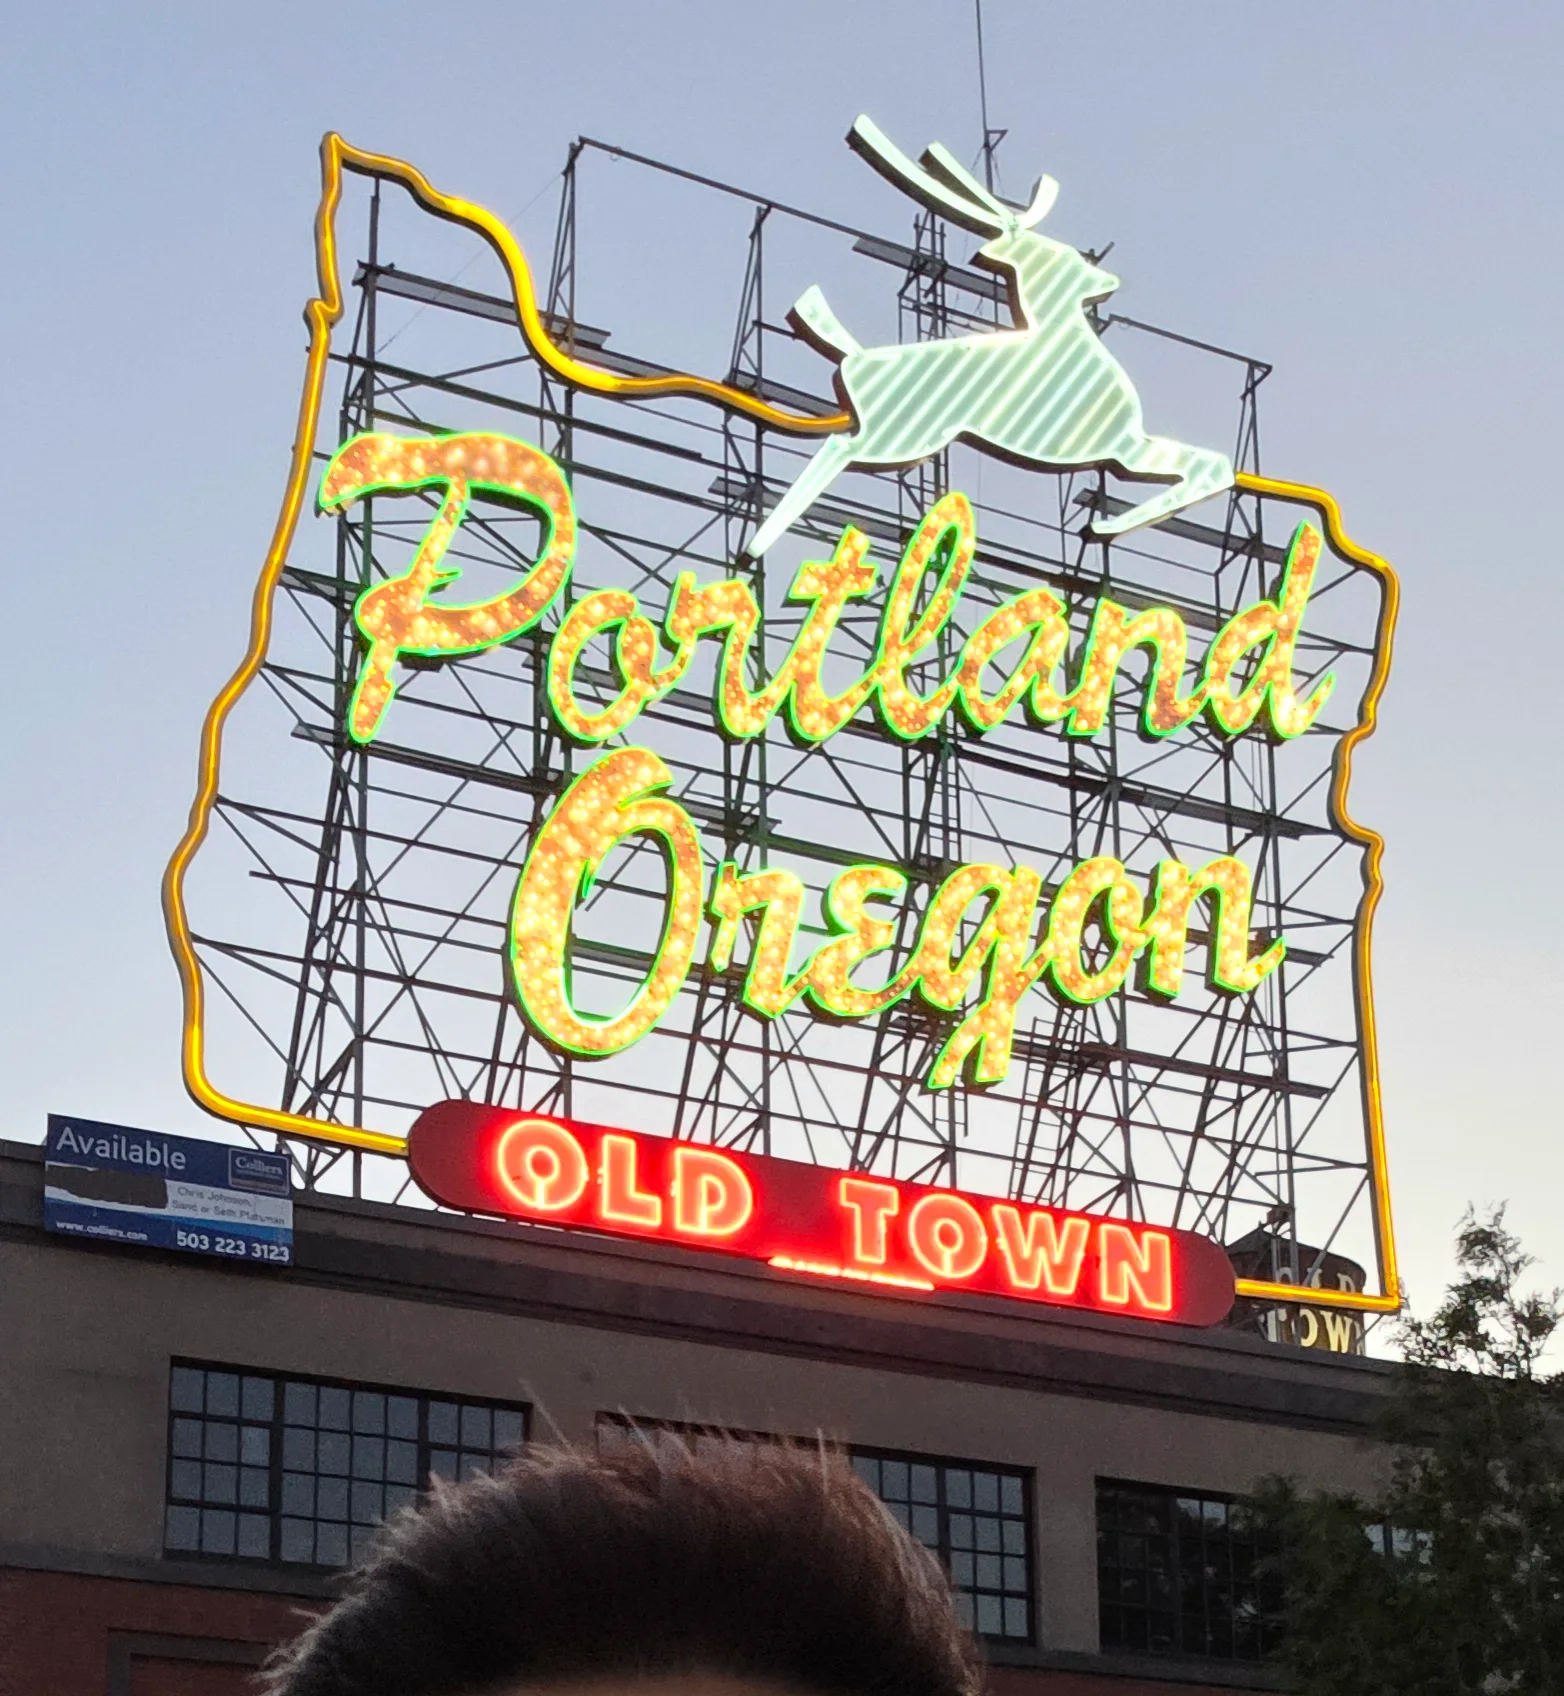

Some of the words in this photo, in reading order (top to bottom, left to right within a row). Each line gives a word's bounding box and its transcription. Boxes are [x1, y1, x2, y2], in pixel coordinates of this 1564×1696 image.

[319, 432, 1334, 744] Portland
[510, 746, 1287, 1088] Oregon
[56, 1126, 186, 1170] Available
[235, 1156, 284, 1176] Colliers
[177, 1230, 210, 1250] 503
[215, 1237, 246, 1256] 223
[251, 1243, 290, 1262] 3123
[496, 1119, 754, 1236] OLD
[838, 1177, 1174, 1312] TOWN
